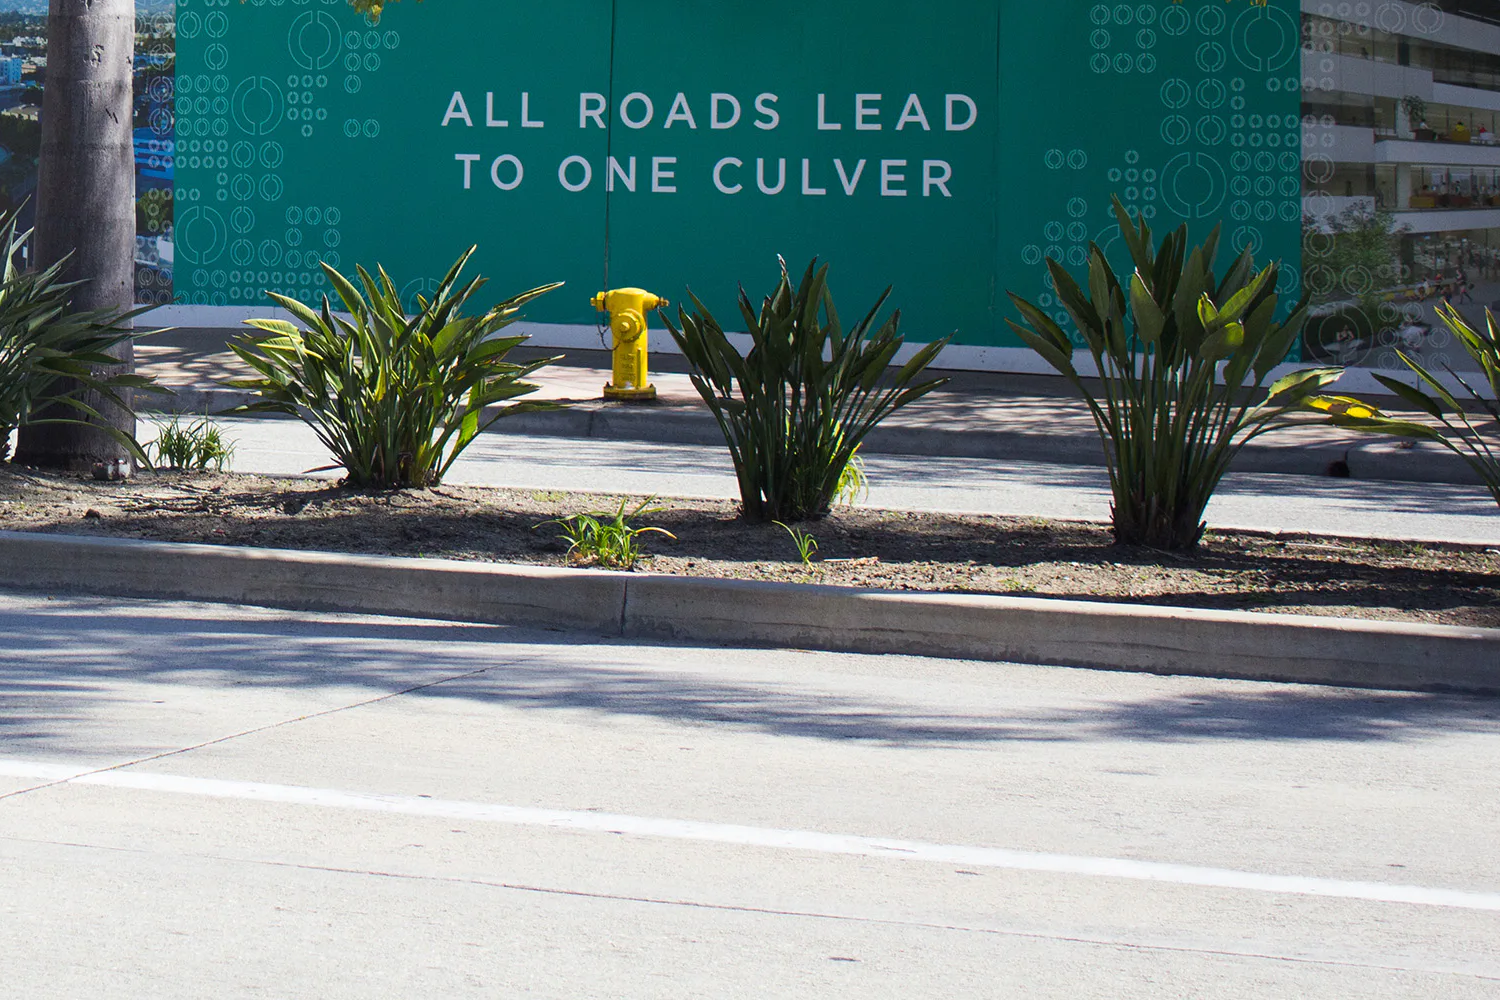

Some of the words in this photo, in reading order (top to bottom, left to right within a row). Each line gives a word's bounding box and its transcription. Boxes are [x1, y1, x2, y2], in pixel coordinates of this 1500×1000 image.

[441, 91, 544, 128] ALL
[579, 92, 780, 131] ROADS
[817, 93, 978, 131] LEAD
[454, 153, 524, 191] TO
[558, 155, 678, 193] ONE
[712, 156, 952, 197] CULVER
